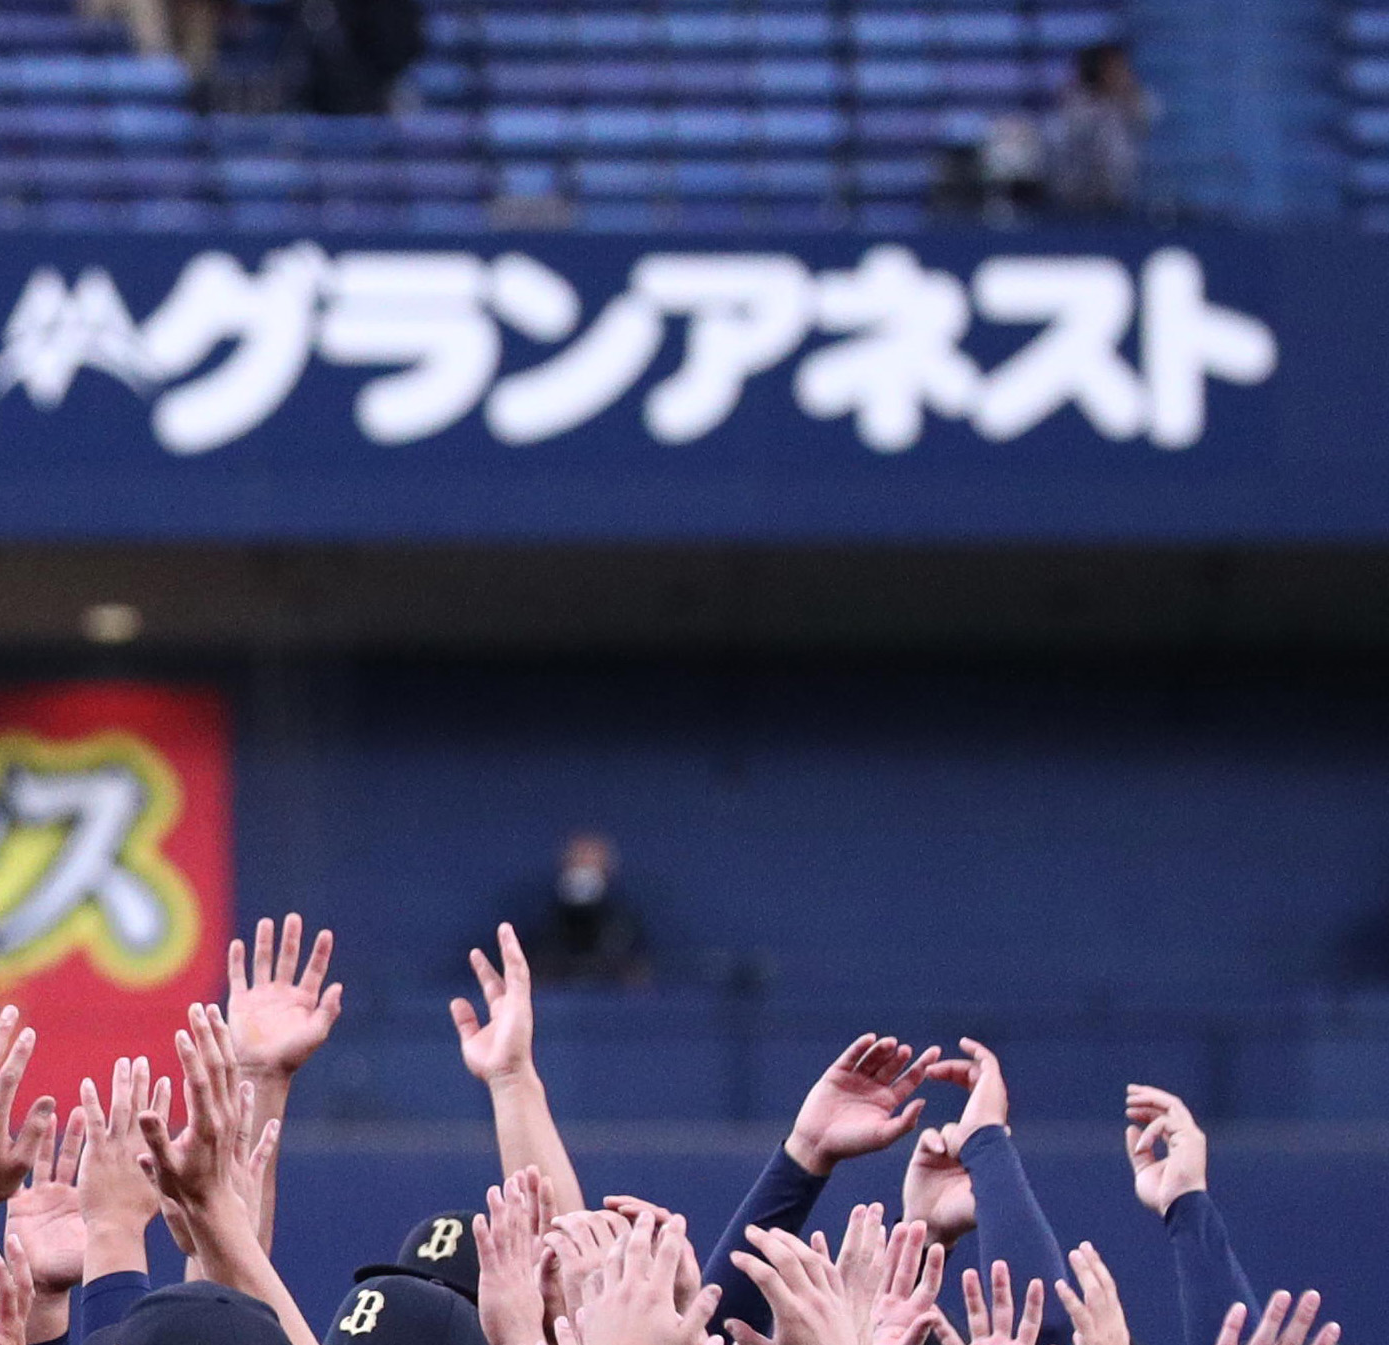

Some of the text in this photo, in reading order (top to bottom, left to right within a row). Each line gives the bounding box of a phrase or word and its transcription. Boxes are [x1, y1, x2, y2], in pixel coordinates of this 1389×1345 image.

[139, 242, 1279, 454] グランアネスト
[417, 1217, 463, 1261] B
[339, 1289, 385, 1336] B
